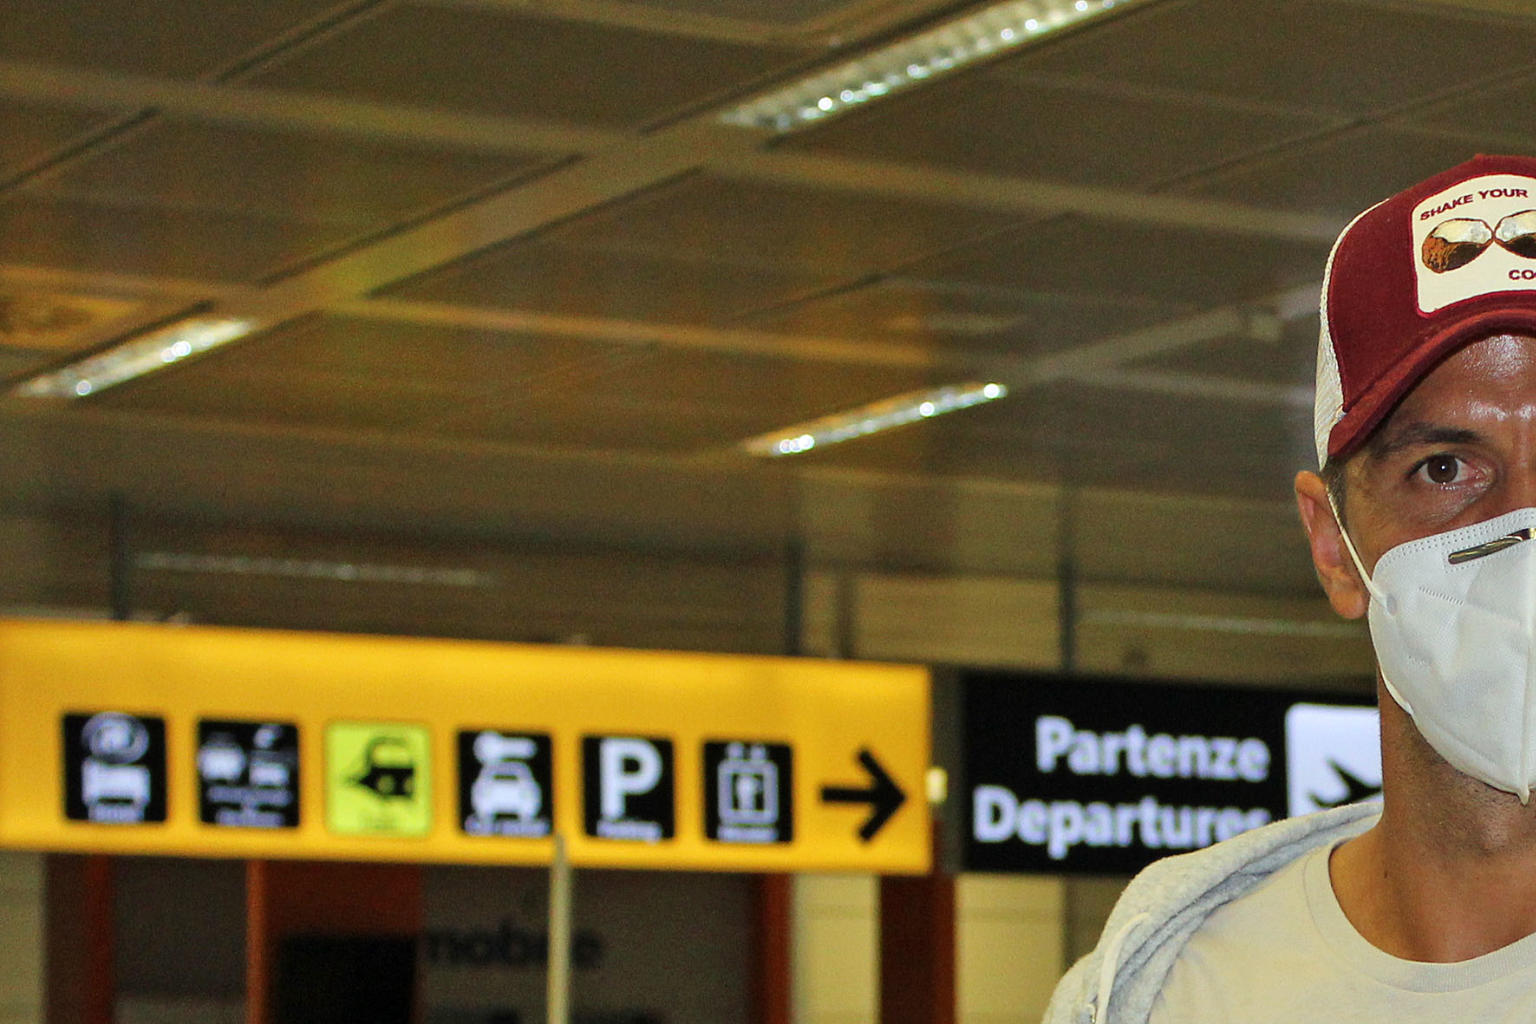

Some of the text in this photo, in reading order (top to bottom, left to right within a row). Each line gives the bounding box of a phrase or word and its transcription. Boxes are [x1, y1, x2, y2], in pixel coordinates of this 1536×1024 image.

[1420, 188, 1528, 220] SHAKE YOUR
[1035, 715, 1270, 783] Partenze
